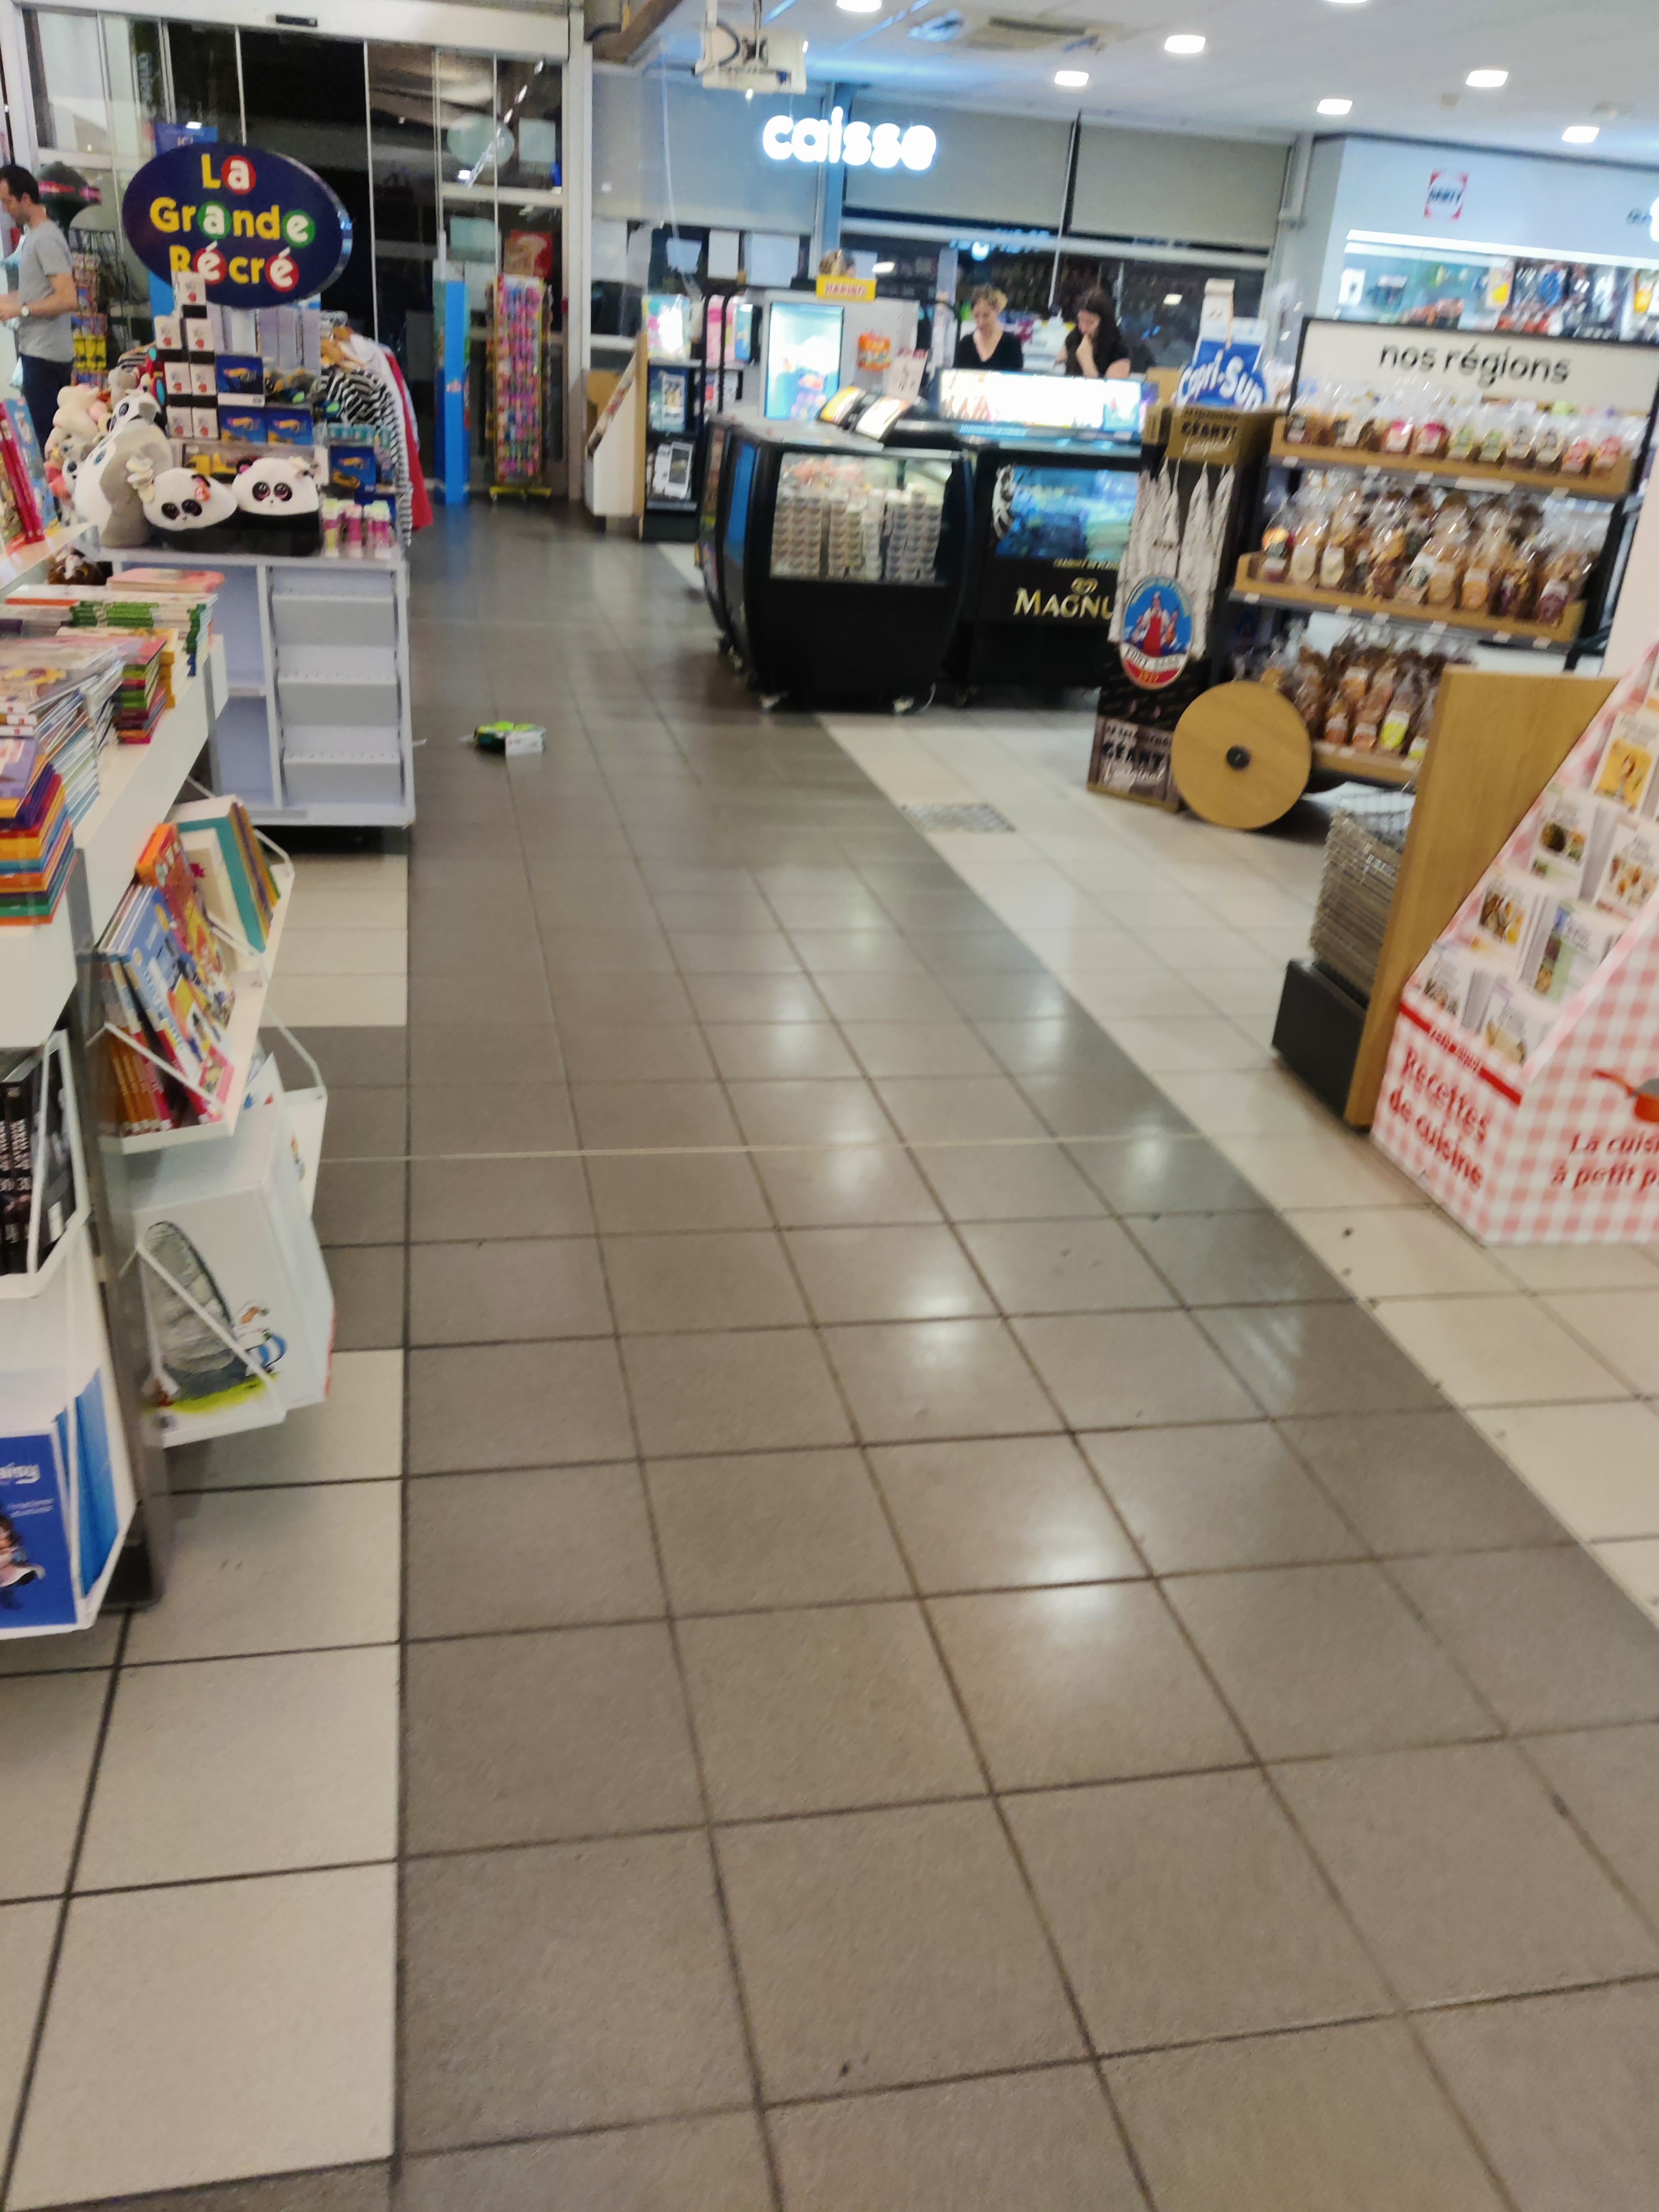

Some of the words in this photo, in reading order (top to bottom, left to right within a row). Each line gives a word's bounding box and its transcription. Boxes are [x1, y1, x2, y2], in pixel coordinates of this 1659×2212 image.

[763, 106, 937, 171] caisse
[201, 153, 250, 190] La
[149, 196, 309, 243] Grande
[169, 240, 295, 288] Récré
[1379, 343, 1437, 373] nos
[1442, 341, 1571, 388] régions
[1013, 586, 1114, 620] MAGNU
[1401, 1045, 1493, 1145] Recettes
[1388, 1084, 1414, 1124] de
[1415, 1115, 1485, 1191] cuisine
[1568, 1132, 1600, 1155] La
